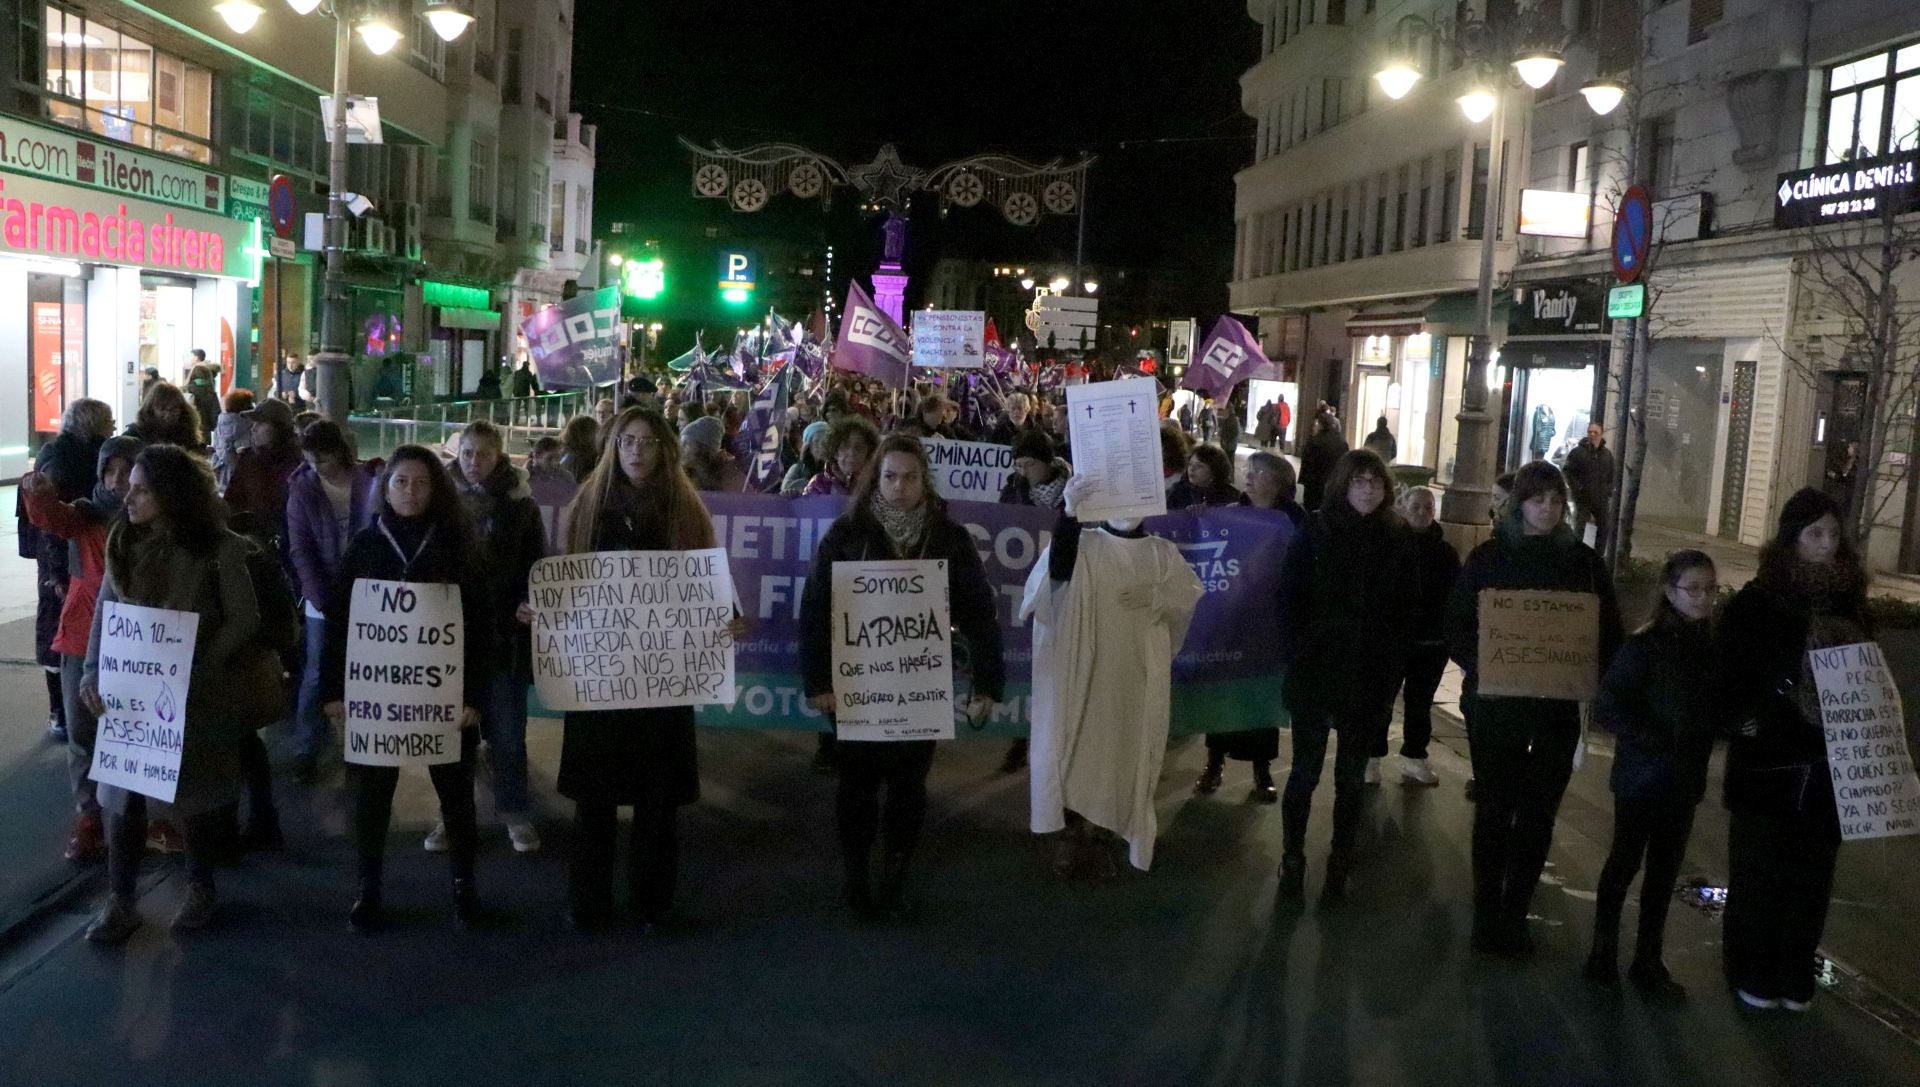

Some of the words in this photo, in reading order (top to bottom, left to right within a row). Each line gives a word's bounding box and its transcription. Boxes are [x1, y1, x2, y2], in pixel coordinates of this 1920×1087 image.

[1793, 173, 1850, 200] CLÍNICA
[0, 180, 145, 262] armacia
[151, 212, 224, 272] sirera
[728, 254, 748, 281] P
[1533, 289, 1577, 327] Vanity
[949, 469, 988, 491] CON
[620, 557, 641, 578] DE
[649, 557, 679, 579] LOS
[685, 555, 718, 577] QUE
[1181, 557, 1241, 580] TAS
[533, 586, 564, 609] HOY
[571, 581, 624, 608] ESTÁN
[630, 579, 671, 605] AQUÍ
[677, 581, 714, 602] VAN
[1493, 597, 1514, 609] NO
[107, 614, 143, 641] CADA
[150, 622, 165, 644] 10
[537, 612, 550, 630] A
[555, 607, 640, 630] EMPEZAR
[647, 609, 660, 629] A
[665, 606, 729, 629] SOLTAR
[356, 622, 408, 643] TODOS
[417, 622, 456, 645] LOS
[844, 612, 871, 648] LA
[536, 634, 560, 654] LA
[564, 631, 634, 654] MIERDA
[640, 630, 676, 651] QUE
[684, 630, 696, 649] A
[703, 630, 732, 648] LAS
[101, 654, 118, 673] UNA
[122, 659, 164, 676] MUJER
[169, 668, 177, 676] O
[538, 654, 625, 678] MUJERES
[633, 652, 674, 676] NOS
[684, 650, 726, 673] HAN
[1814, 647, 1850, 670] NOT
[1858, 641, 1883, 667] ALL
[869, 661, 895, 675] NOS
[1846, 670, 1887, 684] PERO
[575, 676, 637, 702] HECHO
[646, 672, 725, 699] PASAR?
[1821, 689, 1871, 706] PAGAS
[131, 699, 146, 712] ES
[349, 700, 382, 720] PERO
[387, 702, 456, 722] SIEMPRE
[897, 694, 907, 706] A
[1825, 708, 1876, 724] BORRACHA
[351, 732, 369, 753] UN
[375, 732, 445, 757] HOMBRE
[1825, 729, 1837, 742] SI
[1840, 727, 1858, 741] NO
[1834, 747, 1850, 760] SE
[99, 750, 118, 770] POR
[124, 759, 138, 775] UN
[143, 765, 177, 783] HOMBRE
[1833, 767, 1842, 781] A
[1841, 805, 1860, 817] YA
[1867, 801, 1887, 817] NO
[1842, 822, 1876, 835] DECIR
